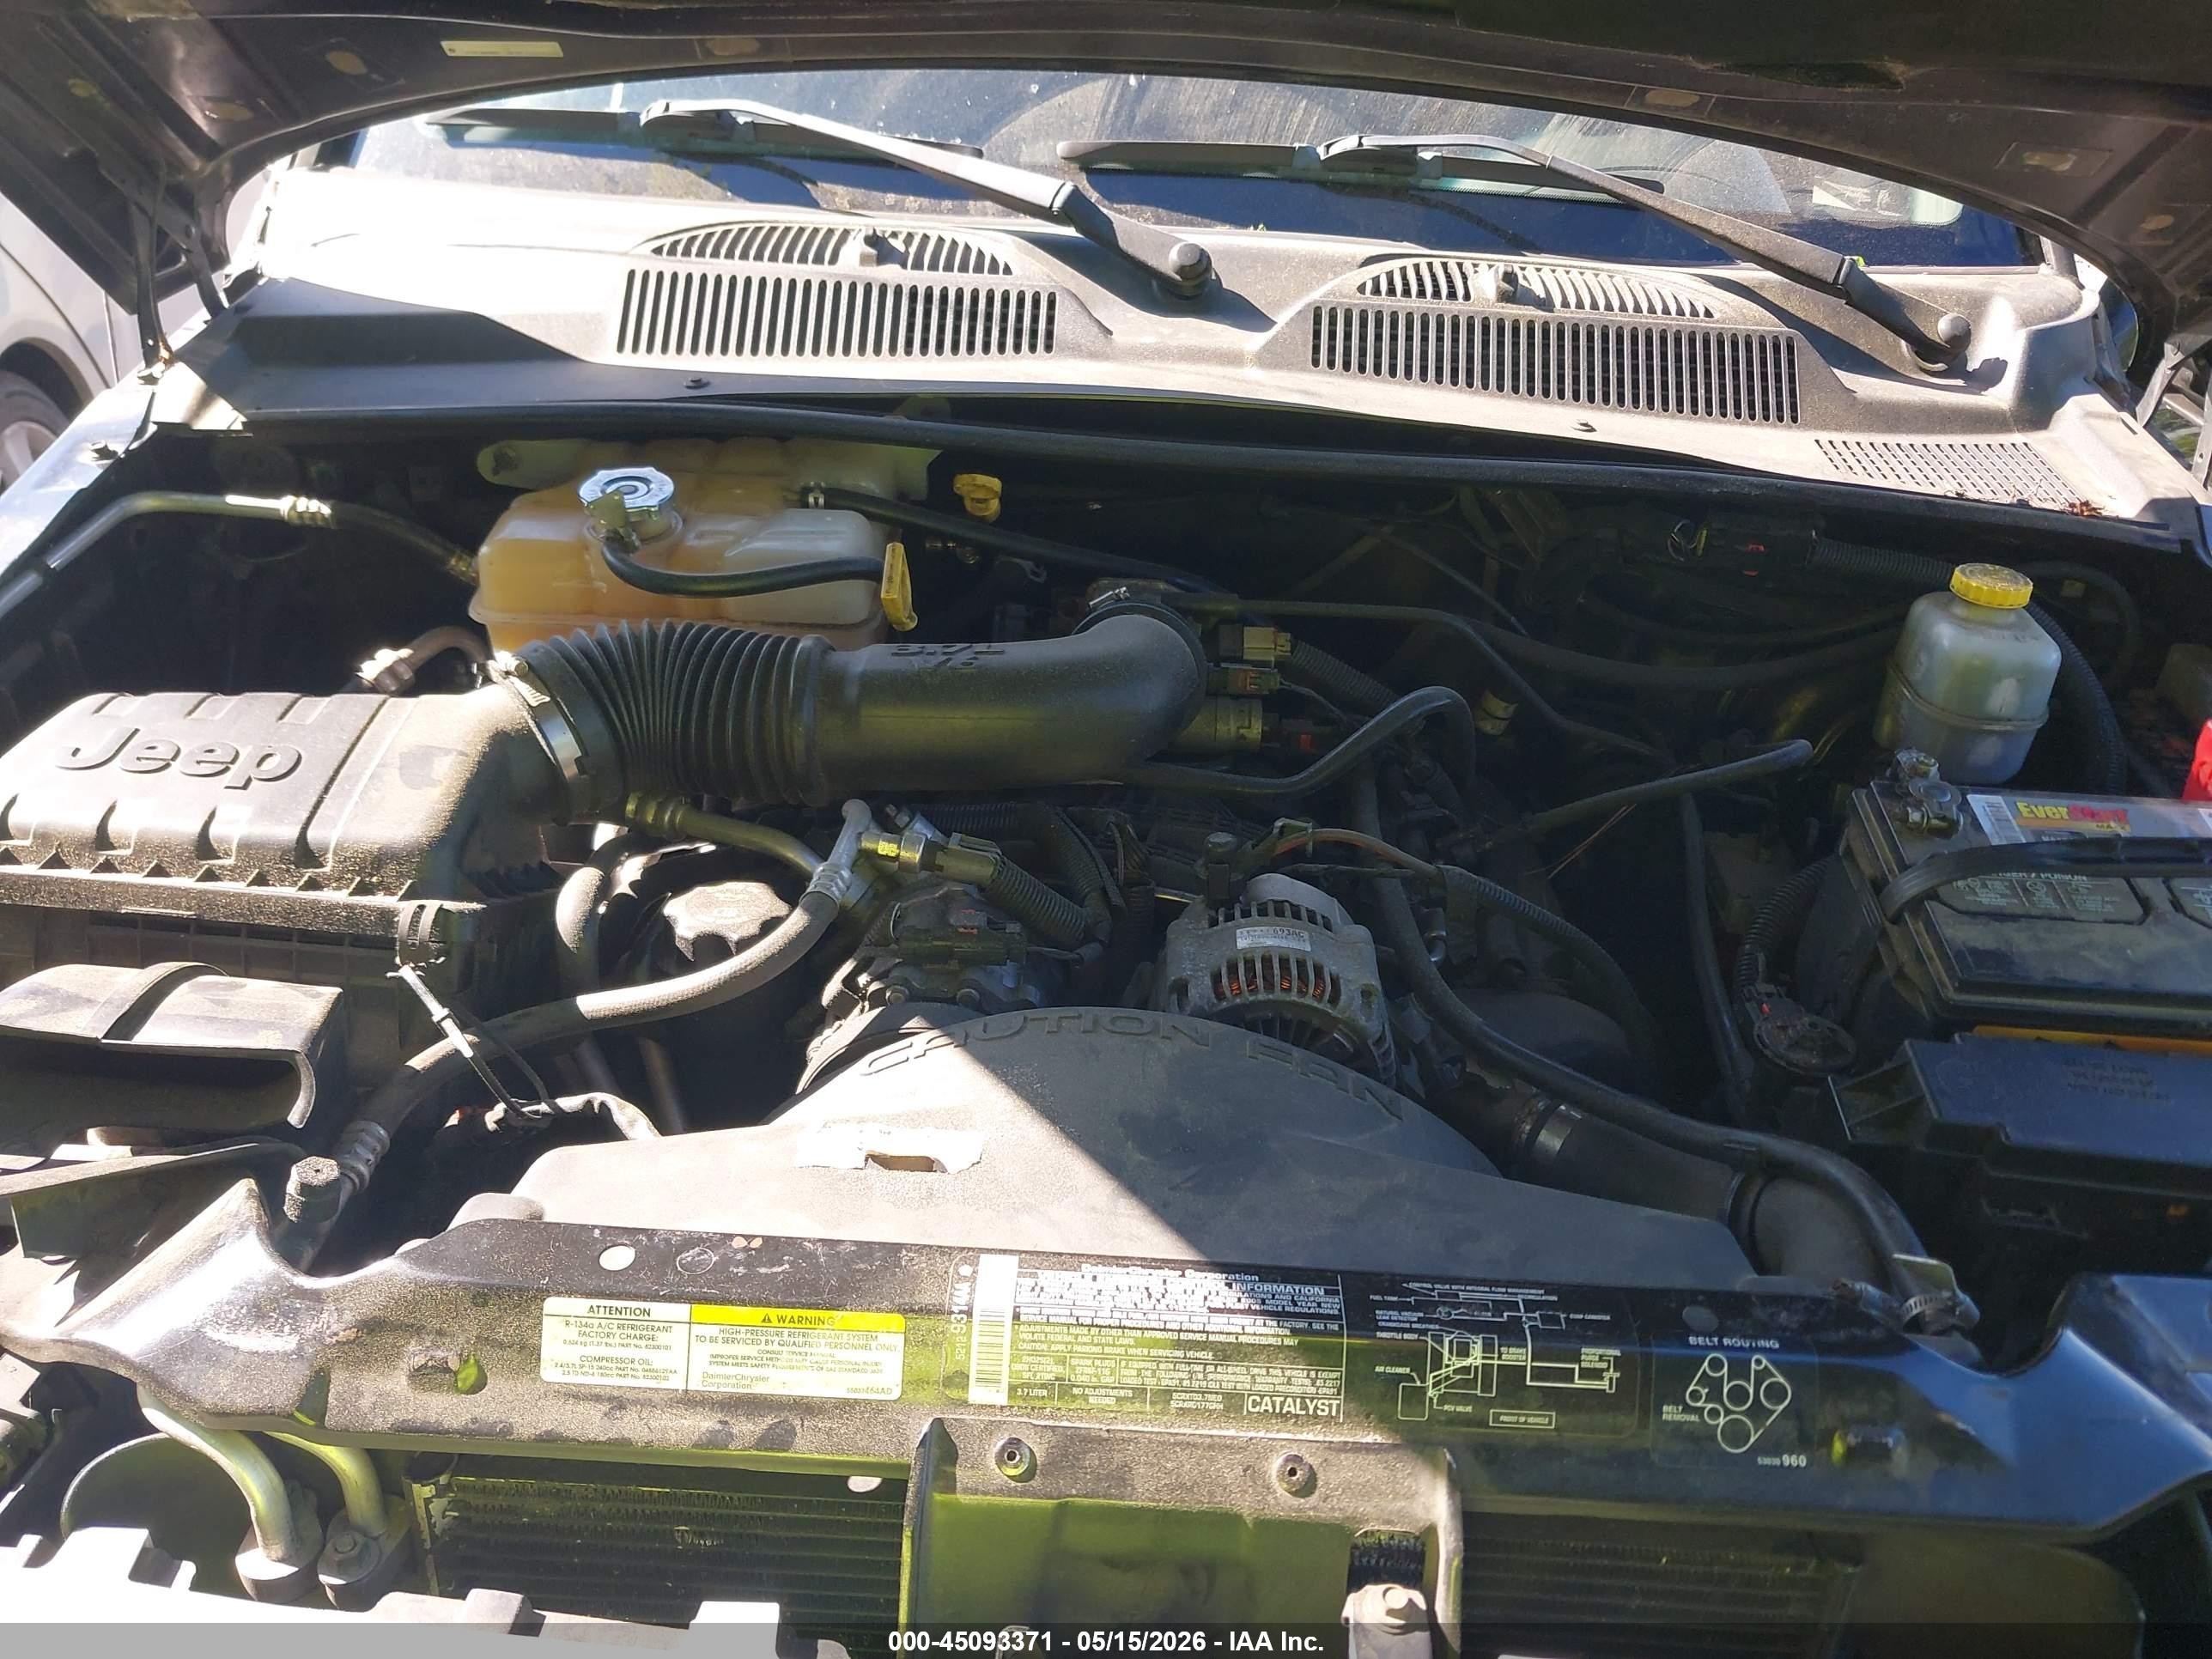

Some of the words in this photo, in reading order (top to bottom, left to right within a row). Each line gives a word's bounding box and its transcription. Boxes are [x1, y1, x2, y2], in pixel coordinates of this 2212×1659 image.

[55, 726, 302, 790] Jeep
[859, 1011, 1211, 1076] CAUTION
[1247, 1037, 1404, 1121] FAN
[1184, 1268, 1259, 1282] Corporation
[1232, 1282, 1325, 1296] INFORMATION
[1294, 1295, 1340, 1304] CALIFORNIA
[586, 1304, 651, 1317] ATTENTION
[776, 1315, 836, 1326] WARNING
[565, 1320, 593, 1329] R-134a
[617, 1323, 672, 1334] REFRIGERANT
[1327, 1322, 1340, 1331] THE
[578, 1330, 617, 1340] FACTORY
[619, 1333, 658, 1341] CHARGE:
[719, 1328, 784, 1338] HIGH-PRESSURE
[787, 1330, 844, 1340] REFRIGERANT
[847, 1333, 878, 1341] SYSTEM
[1020, 1325, 1068, 1334] ADJUSTMENTS
[1144, 1330, 1178, 1340] APPROVED
[1209, 1334, 1237, 1343] MANUAL
[1238, 1335, 1281, 1345] PROCEDURES
[1283, 1338, 1298, 1346] MAY
[1047, 1334, 1076, 1343] FEDERAL
[1093, 1336, 1114, 1345] STATE
[721, 1337, 762, 1346] SERVICED
[777, 1340, 821, 1348] QUALIFIED
[824, 1342, 872, 1351] PERSONNEL
[1688, 1336, 1718, 1346] BELT
[1723, 1338, 1780, 1348] ROUTING
[1127, 1347, 1149, 1356] WHEN
[1150, 1349, 1185, 1358] SERVICING
[580, 1355, 635, 1364] COMPRESSOR
[702, 1371, 770, 1382] DaimlerChrysler
[702, 1380, 752, 1389] Corporation
[1029, 1389, 1048, 1397] LITER
[1085, 1388, 1133, 1398] ADJUSTMENTS
[1248, 1395, 1340, 1416] CATALYST
[1662, 1413, 1700, 1422] REMOVAL
